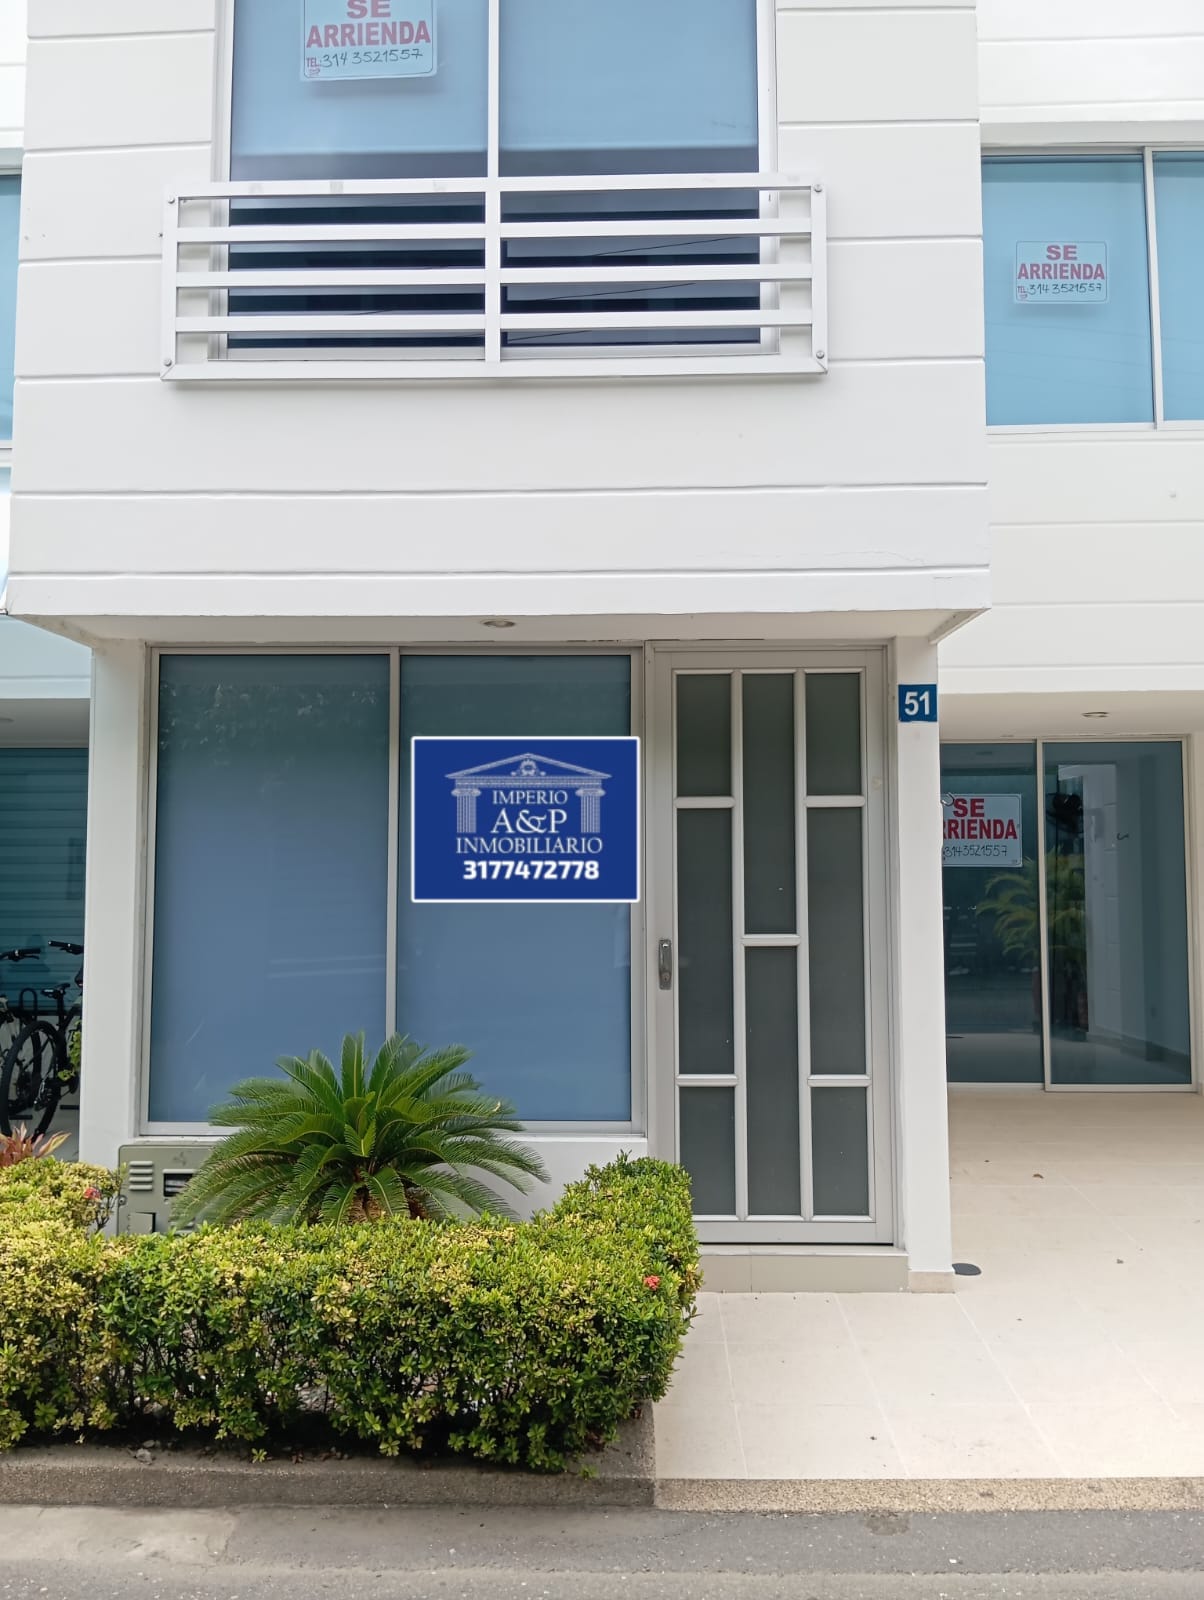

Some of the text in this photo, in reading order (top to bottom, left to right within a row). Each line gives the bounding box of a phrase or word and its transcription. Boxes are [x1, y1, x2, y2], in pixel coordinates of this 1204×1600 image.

[346, 0, 391, 19] SE
[306, 20, 431, 48] ARRIENDA
[351, 48, 423, 64] 3521557
[1046, 245, 1078, 261] SE
[1017, 263, 1105, 280] ARRIENDA
[1052, 282, 1102, 294] 3521557
[904, 691, 930, 715] 51
[953, 798, 985, 818] SE
[943, 819, 1018, 840] RIENDA
